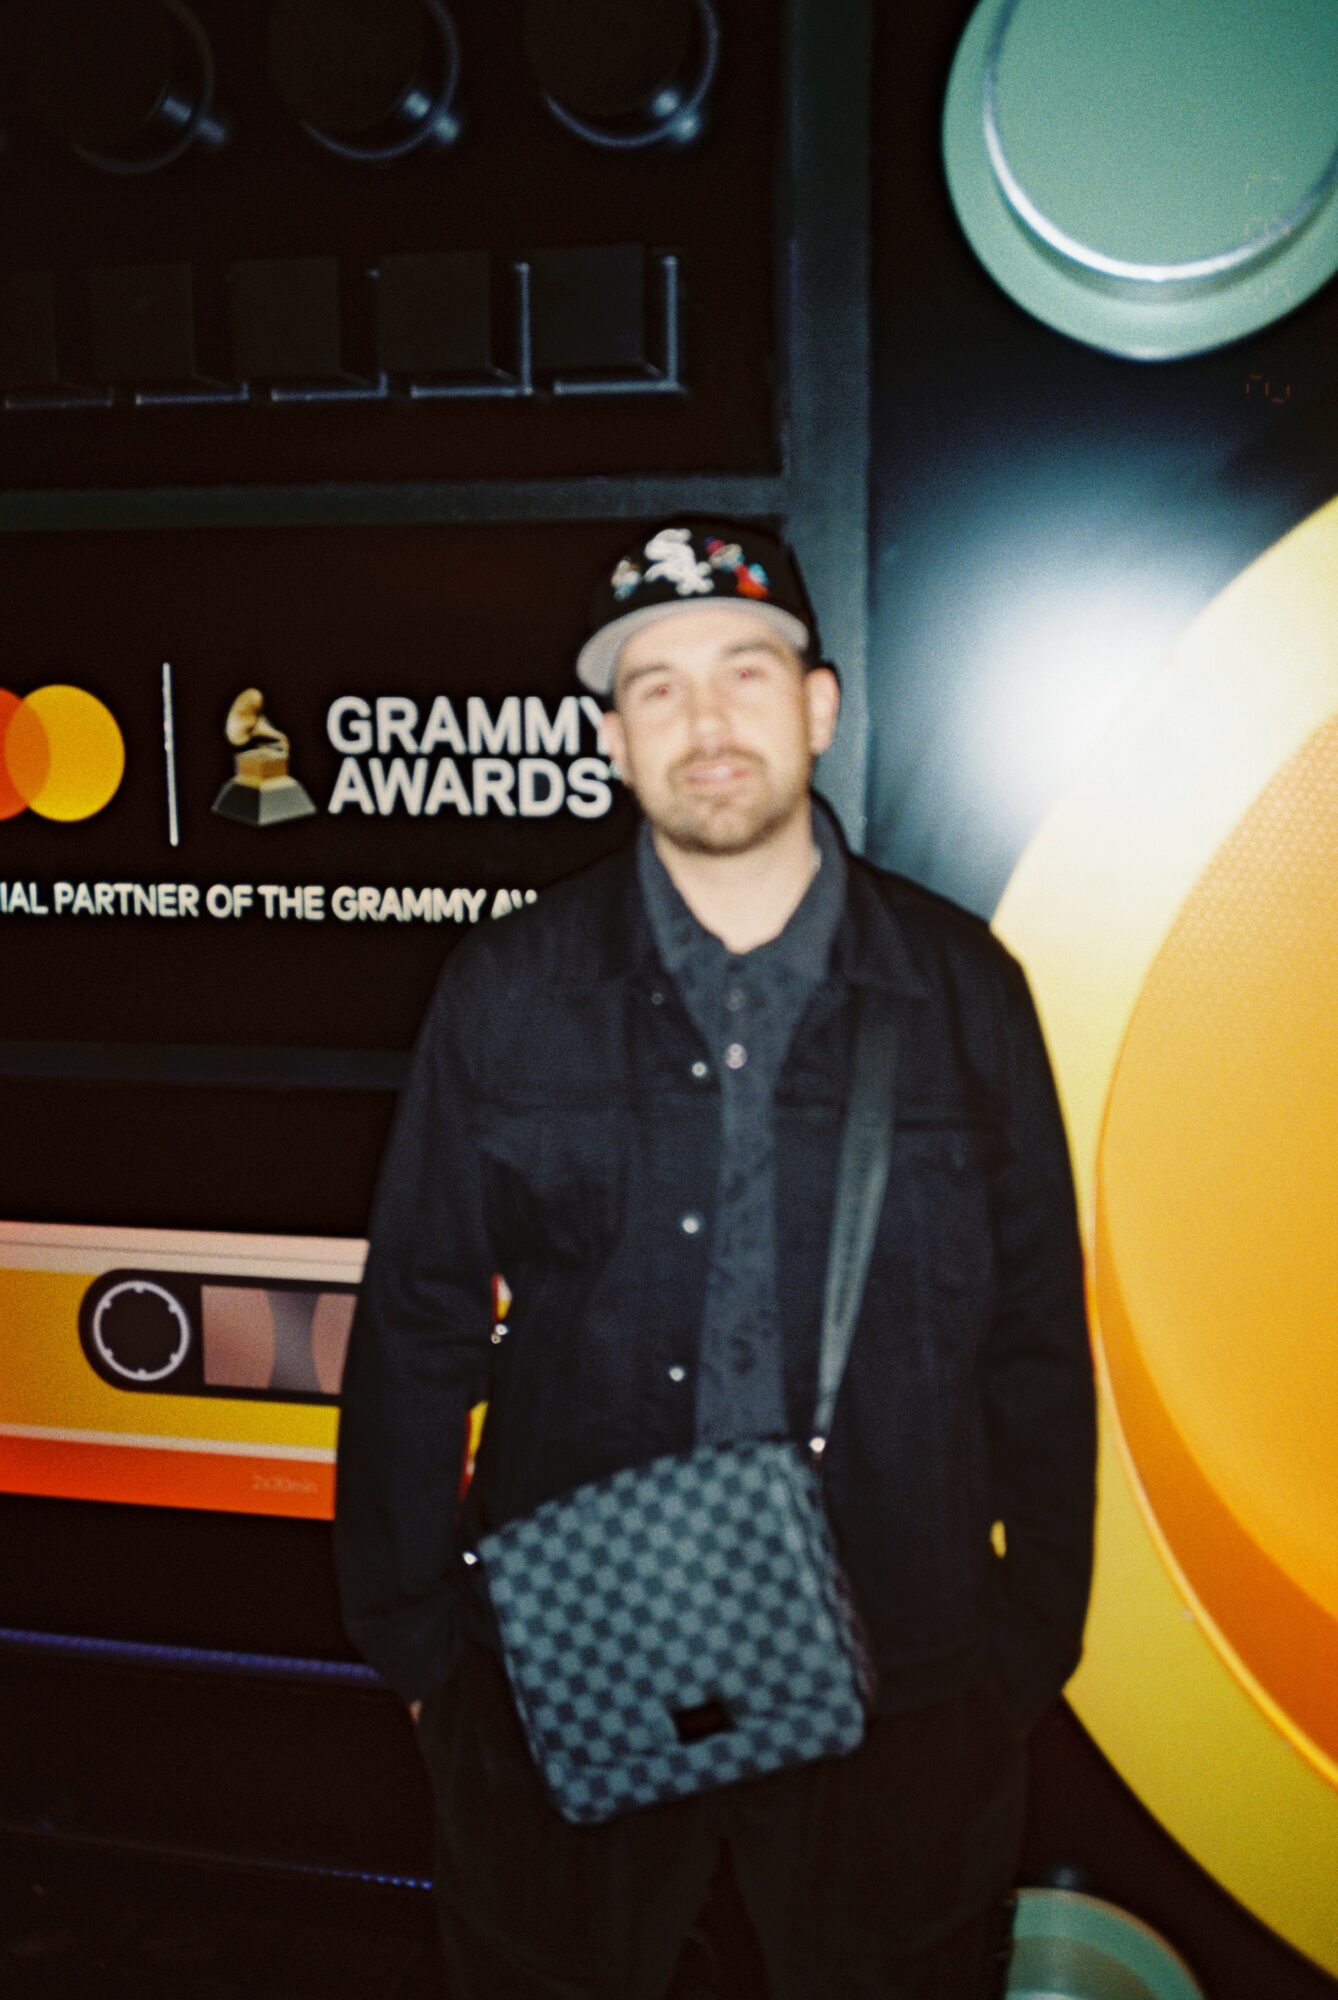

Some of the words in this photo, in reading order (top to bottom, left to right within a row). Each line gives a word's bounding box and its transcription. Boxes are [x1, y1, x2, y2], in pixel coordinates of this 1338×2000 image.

[328, 757, 612, 819] AWARDS
[53, 882, 200, 917] PARTNER
[206, 884, 254, 918] OF
[257, 885, 325, 919] THE
[331, 886, 487, 923] GRAMMY
